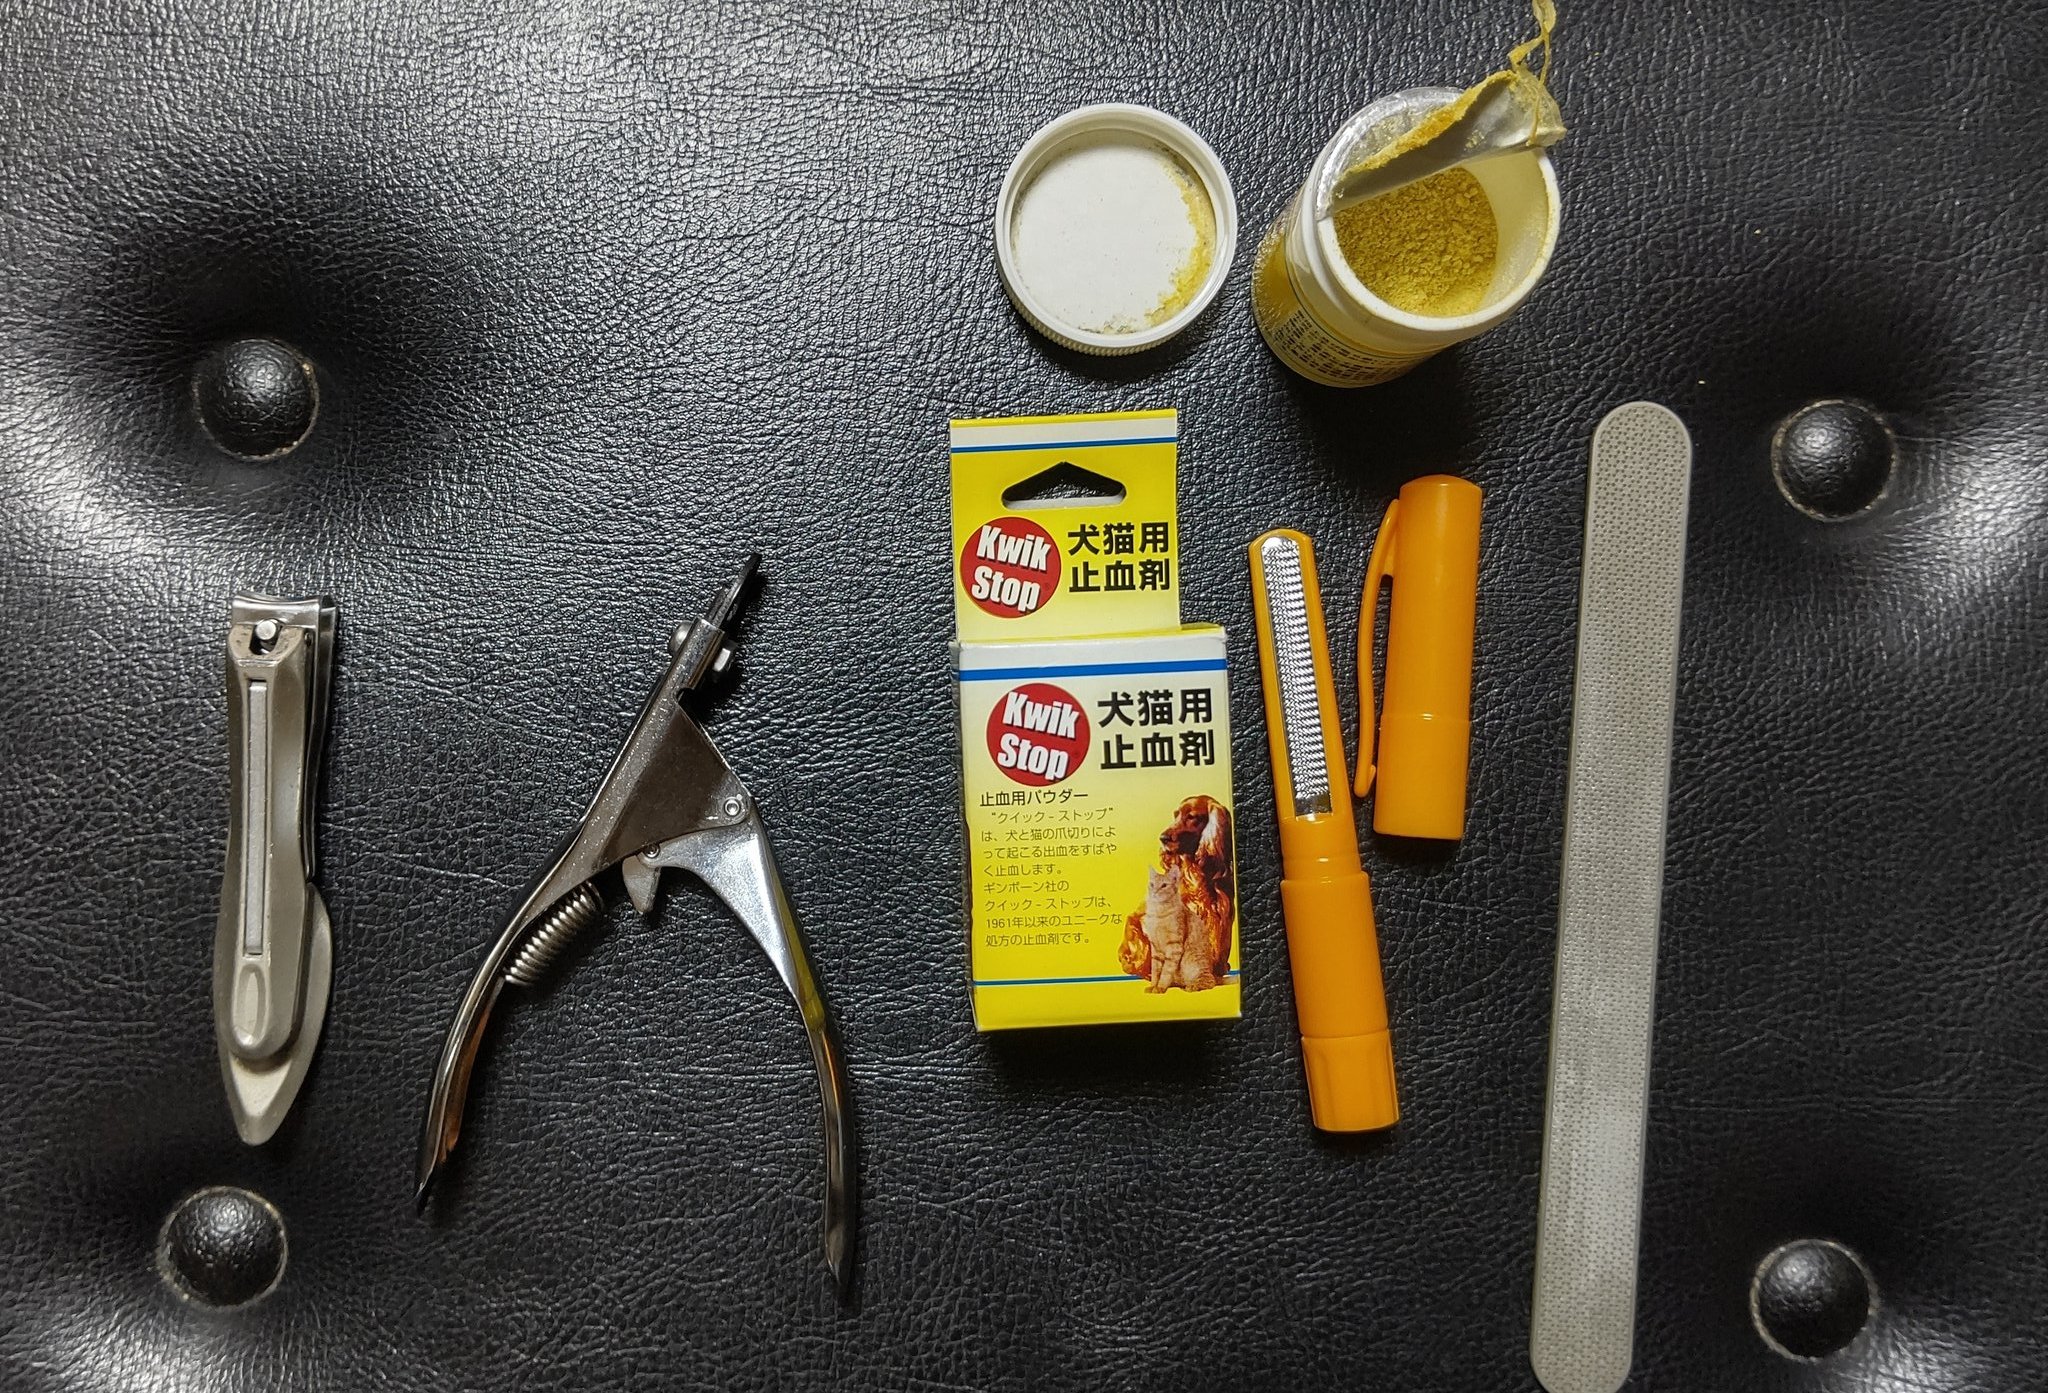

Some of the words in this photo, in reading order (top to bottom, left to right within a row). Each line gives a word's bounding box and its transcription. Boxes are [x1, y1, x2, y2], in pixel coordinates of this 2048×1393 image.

[976, 525, 1051, 571] Kwik
[1067, 522, 1170, 556] 犬猫用
[971, 566, 1041, 612] Stop
[1068, 559, 1171, 592] 止血剤
[1002, 692, 1080, 739] Kwik
[1097, 688, 1213, 728] 犬猫用
[997, 733, 1070, 780] Stop
[1100, 731, 1215, 770] 止血剤
[980, 789, 1089, 807] 止血用パウダー
